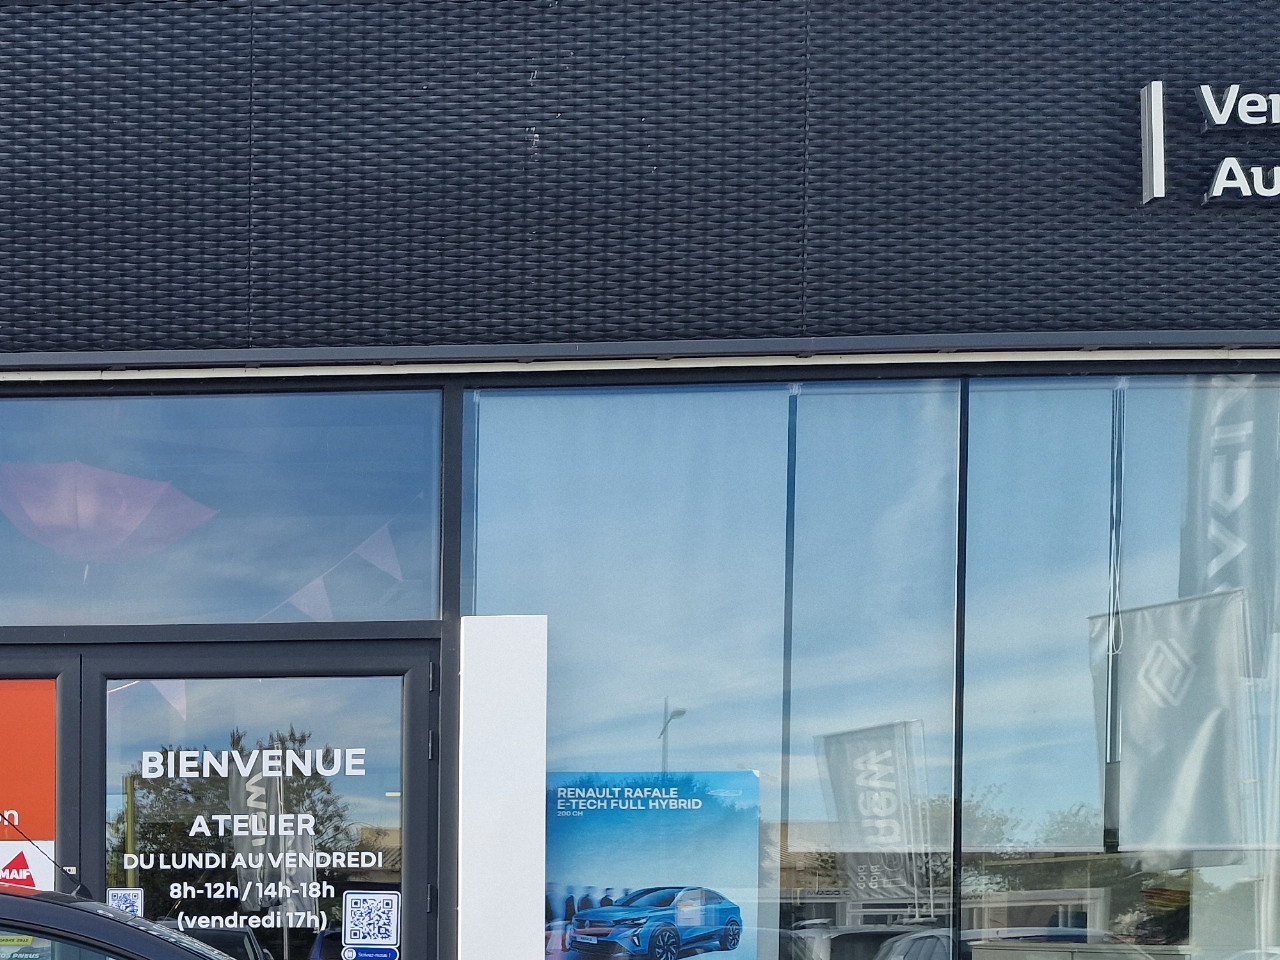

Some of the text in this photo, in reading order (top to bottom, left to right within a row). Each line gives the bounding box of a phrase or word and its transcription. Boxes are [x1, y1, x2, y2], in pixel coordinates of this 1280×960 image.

[141, 748, 366, 779] BIENVENUE
[557, 787, 678, 798] RENAULT RAFALE
[557, 799, 703, 809] E-TECH FULL HYBRID
[189, 814, 315, 837] ATELIER
[123, 851, 383, 869] DU LUNDI AU VENDREDI
[169, 881, 335, 901] 8h-12h / 14h-18h
[177, 910, 328, 932] (vendredi 17h)
